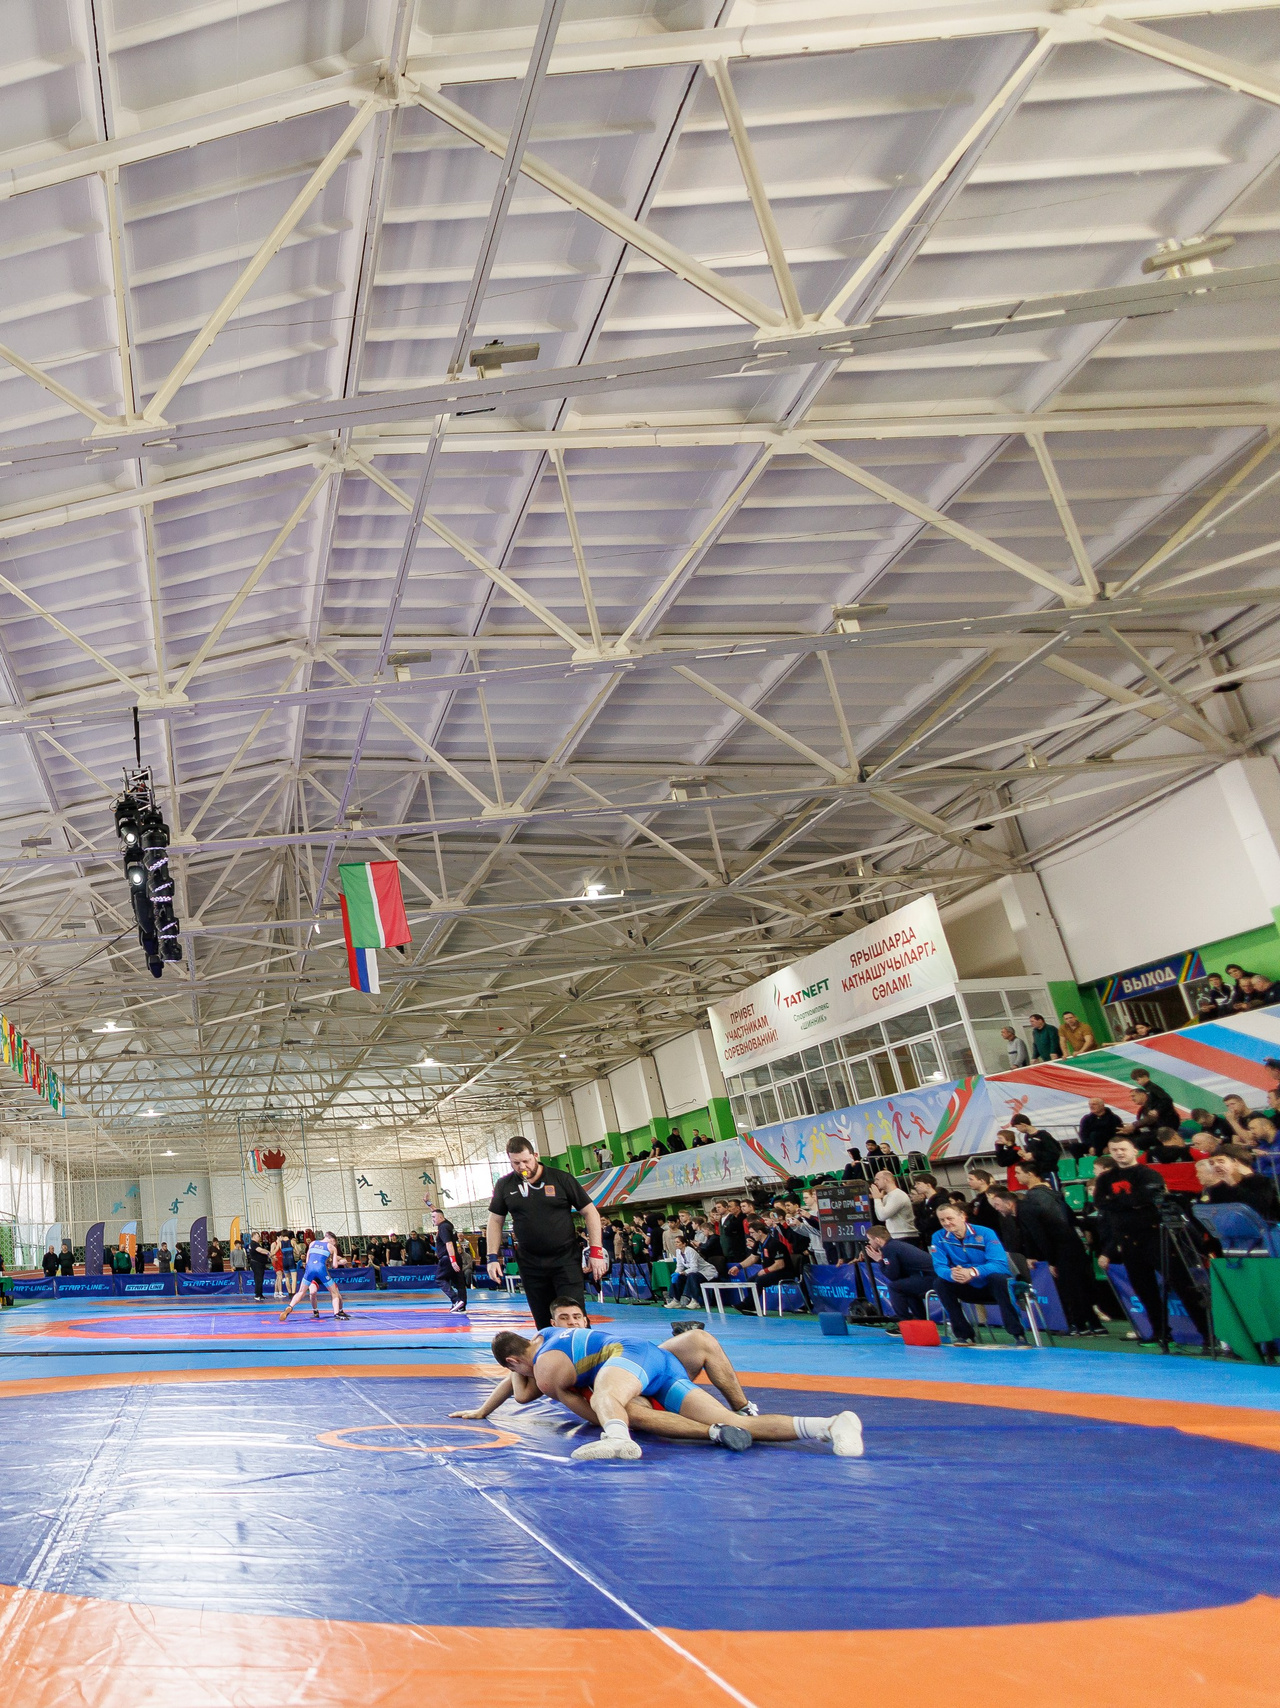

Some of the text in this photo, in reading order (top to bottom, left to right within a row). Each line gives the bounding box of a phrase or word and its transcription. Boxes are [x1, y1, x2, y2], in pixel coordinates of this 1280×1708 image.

[850, 926, 916, 968] ЯРЫШЛАРДА
[841, 940, 938, 992] КАТНАШУЧЫЛАРГА
[872, 973, 912, 1001] СӘЛАМ!
[1122, 966, 1177, 994] ВЫХОД
[784, 978, 830, 1008] TATNEFT
[730, 1003, 755, 1024] ПРИВЕТ
[793, 1002, 830, 1023] Спорткомплекс
[725, 1015, 769, 1043] УЧАСТНИКАМ
[724, 1030, 779, 1060] СОРЕВНОВАНИЙ!
[831, 1200, 842, 1210] САР
[826, 1226, 832, 1238] 0
[837, 1225, 855, 1236] 3:22
[860, 1225, 866, 1237] 0
[125, 1283, 164, 1291] START LINE
